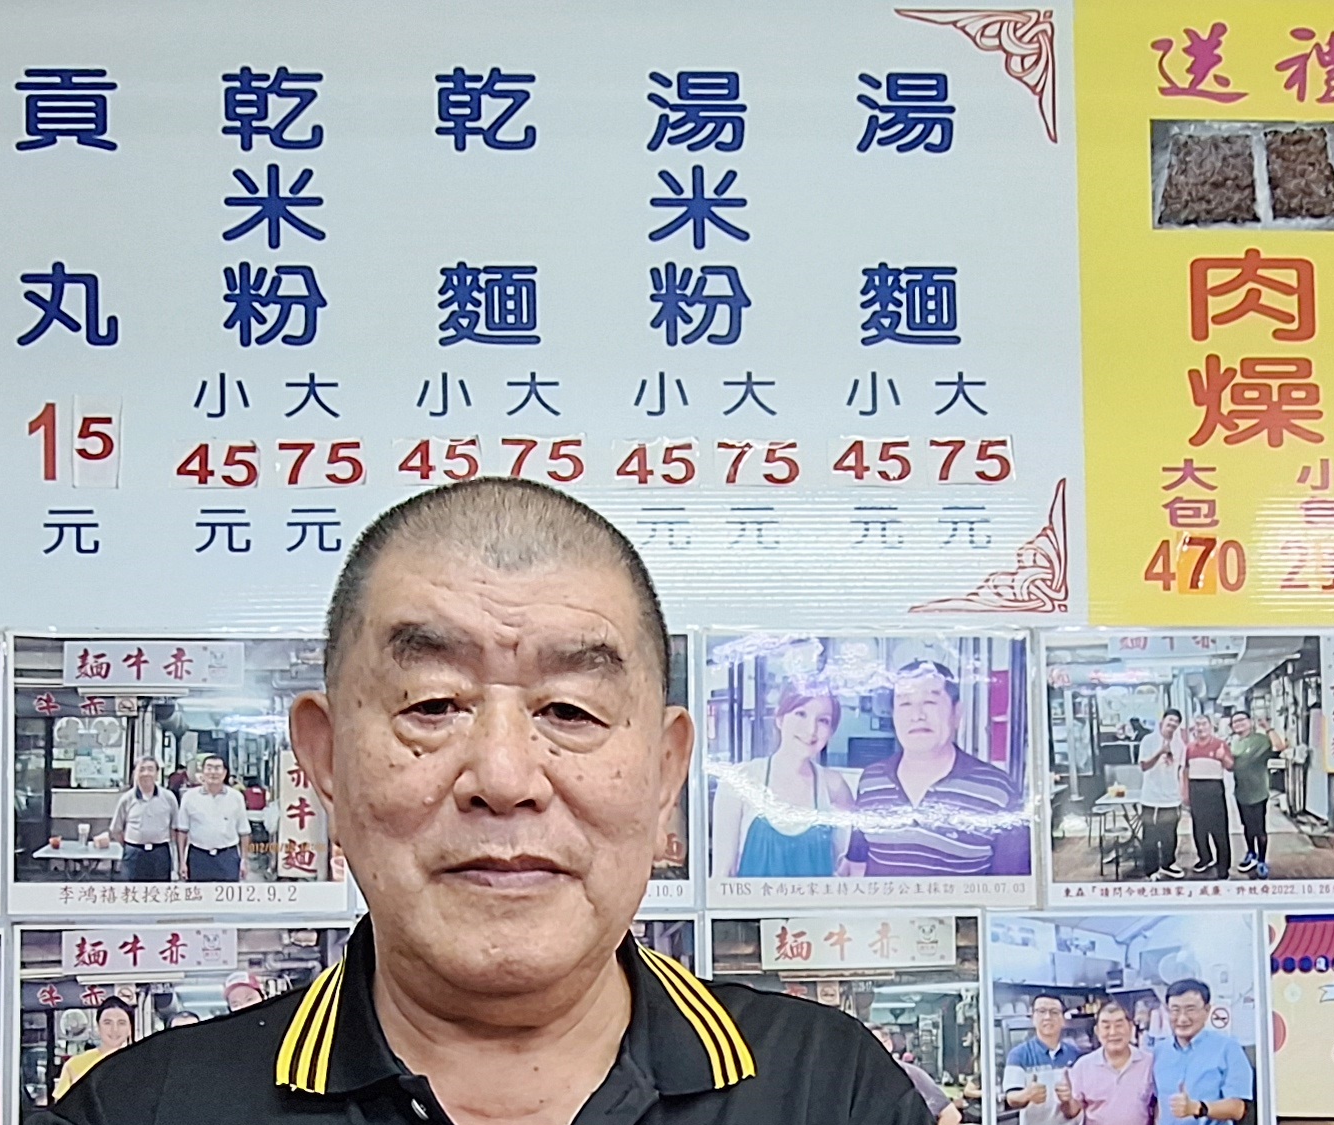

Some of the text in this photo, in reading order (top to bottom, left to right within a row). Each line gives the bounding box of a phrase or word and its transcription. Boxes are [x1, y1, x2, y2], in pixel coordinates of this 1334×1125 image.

[15, 67, 119, 347] 貢丸
[221, 66, 327, 348] 乾米粉
[434, 67, 541, 346] 乾麵
[646, 69, 752, 346] 湯米粉
[855, 72, 962, 347] 湯麵
[1188, 248, 1324, 448] 肉燥
[193, 372, 340, 418] 小 大
[416, 371, 560, 417] 小 大
[633, 371, 776, 417] 小 大
[846, 371, 988, 417] 小 大
[28, 402, 115, 482] 15
[176, 441, 364, 488] 45 75
[398, 437, 585, 482] 45 75
[616, 440, 800, 485] 45 75
[833, 438, 1012, 483] 45 75
[1160, 459, 1220, 528] 大包
[43, 510, 100, 555] 元
[195, 509, 342, 554] 元 元
[635, 506, 781, 550] 元 元
[850, 506, 992, 550] 元 元
[1144, 536, 1247, 591] 470
[215, 886, 298, 902] 2012.9.2
[720, 882, 752, 896] TVBS
